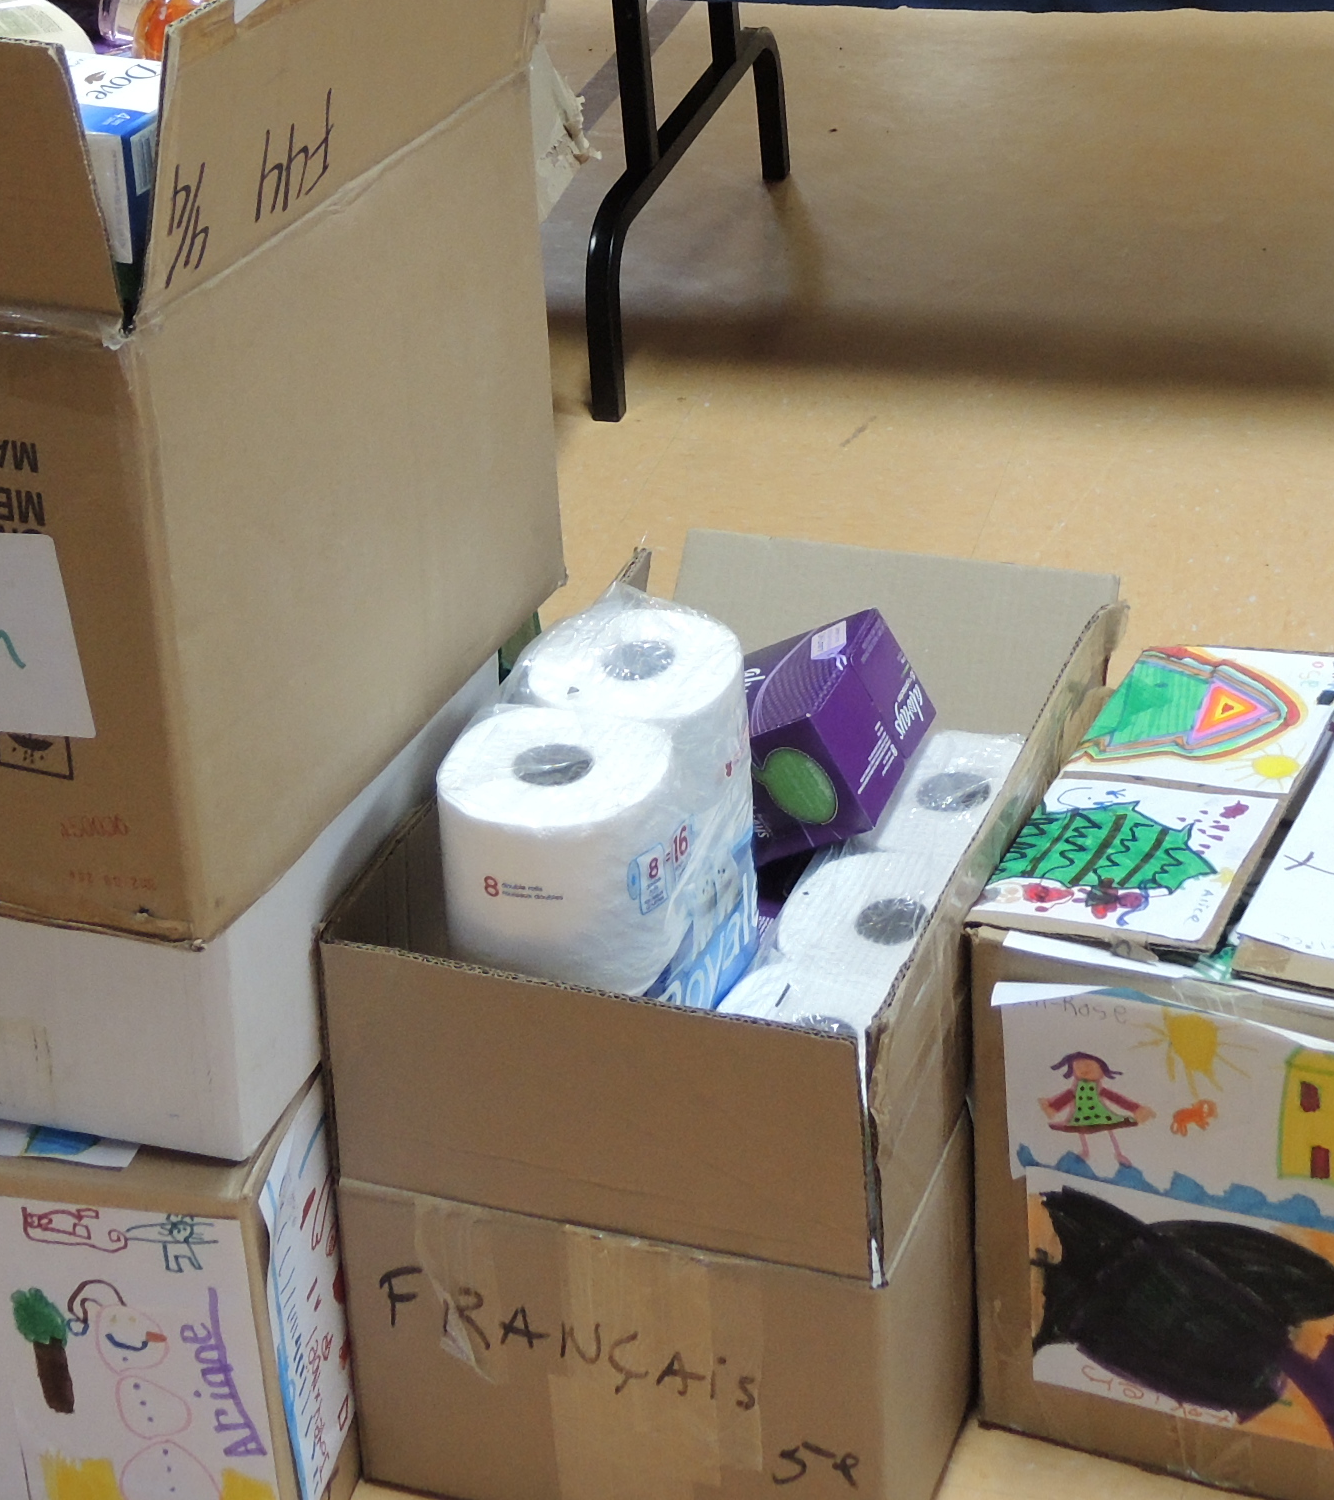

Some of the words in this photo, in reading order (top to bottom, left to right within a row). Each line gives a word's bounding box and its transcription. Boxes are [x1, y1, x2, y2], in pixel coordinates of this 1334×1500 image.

[86, 63, 158, 101] Dove
[647, 856, 660, 880] 8
[672, 823, 689, 863] 16
[483, 875, 500, 898] 8
